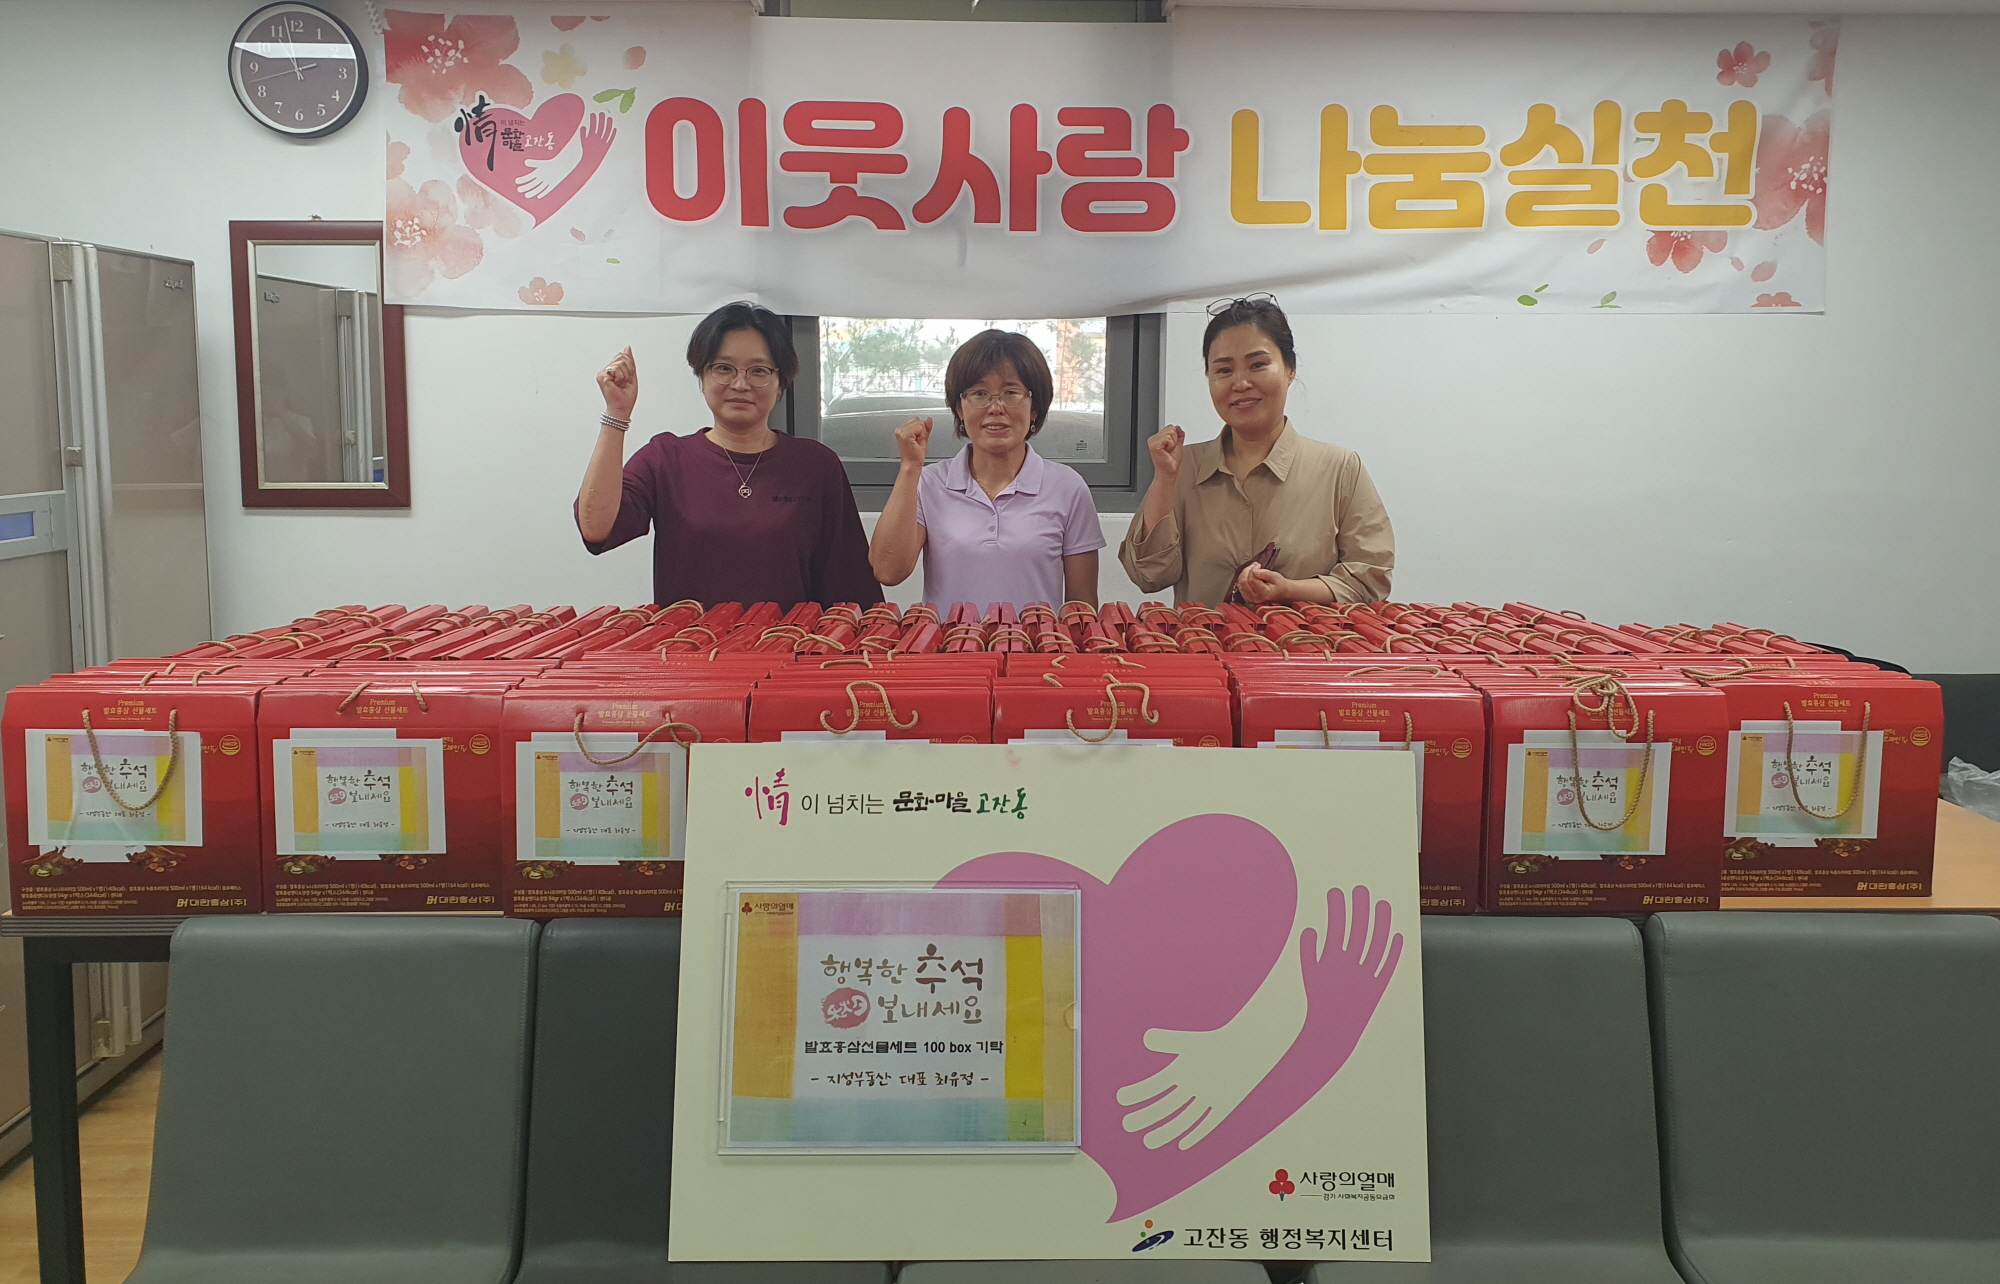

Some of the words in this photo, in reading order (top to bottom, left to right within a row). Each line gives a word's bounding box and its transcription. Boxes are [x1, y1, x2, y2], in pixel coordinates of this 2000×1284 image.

[270, 25, 283, 38] 11
[290, 20, 304, 33] 12
[316, 28, 322, 40] 1
[249, 61, 259, 74] 9
[338, 67, 348, 80] 3
[257, 85, 267, 98] 8
[331, 89, 340, 101] 4
[274, 101, 283, 114] 7
[317, 103, 326, 116] 5
[295, 109, 304, 121] 6
[454, 94, 497, 171] 情
[501, 128, 525, 140] 문화
[502, 140, 524, 151] 마을
[524, 132, 555, 150] 고잔동
[645, 96, 1190, 232] 이웃사랑
[1229, 98, 1757, 231] 나눔실천
[845, 708, 871, 717] 발홍삼
[80, 762, 116, 776] 행한
[119, 758, 147, 779] 추석
[1805, 755, 1832, 775] 추석
[325, 774, 361, 787] 행복한
[363, 769, 391, 790] 추석
[568, 779, 603, 793] 행복한
[606, 774, 633, 796] 추석
[1591, 770, 1619, 791] 추석
[349, 790, 391, 803] 보내세요
[591, 796, 633, 808] 보내세요
[744, 768, 790, 826] 情
[801, 793, 819, 814] 이
[827, 793, 885, 815] 넘치는
[976, 787, 1028, 820] 고잔동
[1582, 791, 1617, 804] 내세요
[820, 953, 908, 985] 행복한
[915, 943, 984, 994] 추석
[877, 995, 983, 1024] 보내세요
[804, 1040, 918, 1054] 발효홍삼선물세트
[923, 1041, 946, 1054] 100
[949, 1041, 972, 1053] box
[977, 1040, 1004, 1054] 기탁
[826, 1072, 892, 1087] 지성부동산
[899, 1072, 928, 1087] 대표
[935, 1072, 974, 1087] 최유정
[1300, 1171, 1395, 1191] 사랑의열매
[1183, 1227, 1250, 1250] 고잔동
[1259, 1227, 1394, 1251] 행정복지센터
